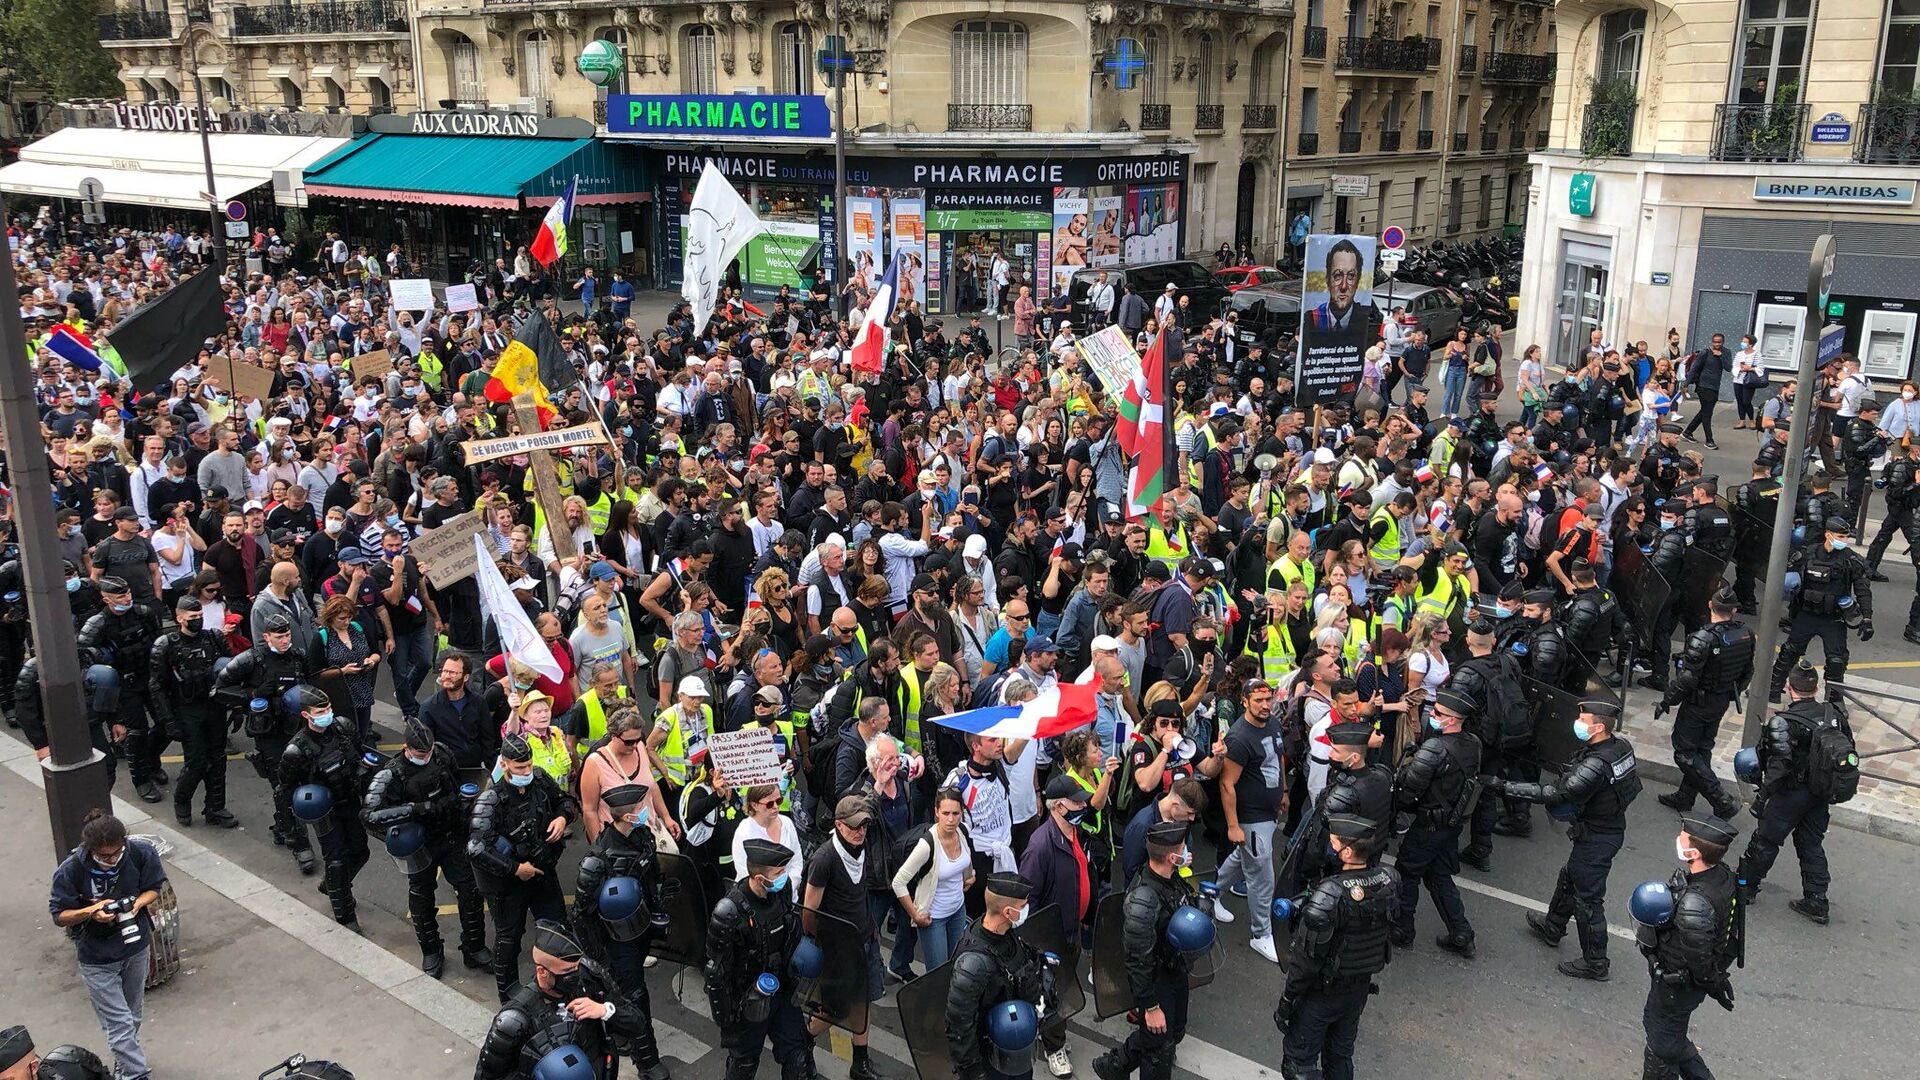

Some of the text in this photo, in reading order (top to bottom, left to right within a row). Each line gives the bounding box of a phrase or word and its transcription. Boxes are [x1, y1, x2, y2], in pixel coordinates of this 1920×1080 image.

[629, 102, 800, 129] PHARMACIE
[412, 113, 538, 136] AUX CADRANS
[782, 167, 797, 178] DU
[801, 168, 835, 180] TRAIN
[847, 171, 870, 182] LEU
[914, 165, 1063, 182] PHARMACIE
[1097, 161, 1180, 181] ORTHOPEDIE
[1769, 184, 1898, 198] BNP PARIBAS
[934, 195, 1042, 205] PARAPHARMACIE
[1099, 199, 1116, 207] VICHY
[764, 244, 803, 256] Bienvenue
[766, 257, 800, 268] Welcom
[1345, 345, 1358, 353] faire
[1317, 356, 1341, 366] politique
[1342, 355, 1359, 364] quand
[1313, 377, 1326, 385] nous
[1327, 375, 1340, 383] faire
[485, 440, 518, 455] VACCIN
[527, 433, 560, 448] POISON
[712, 733, 732, 744] PASS
[715, 751, 745, 760] ASSURANCE
[717, 758, 749, 767] RETRAITE
